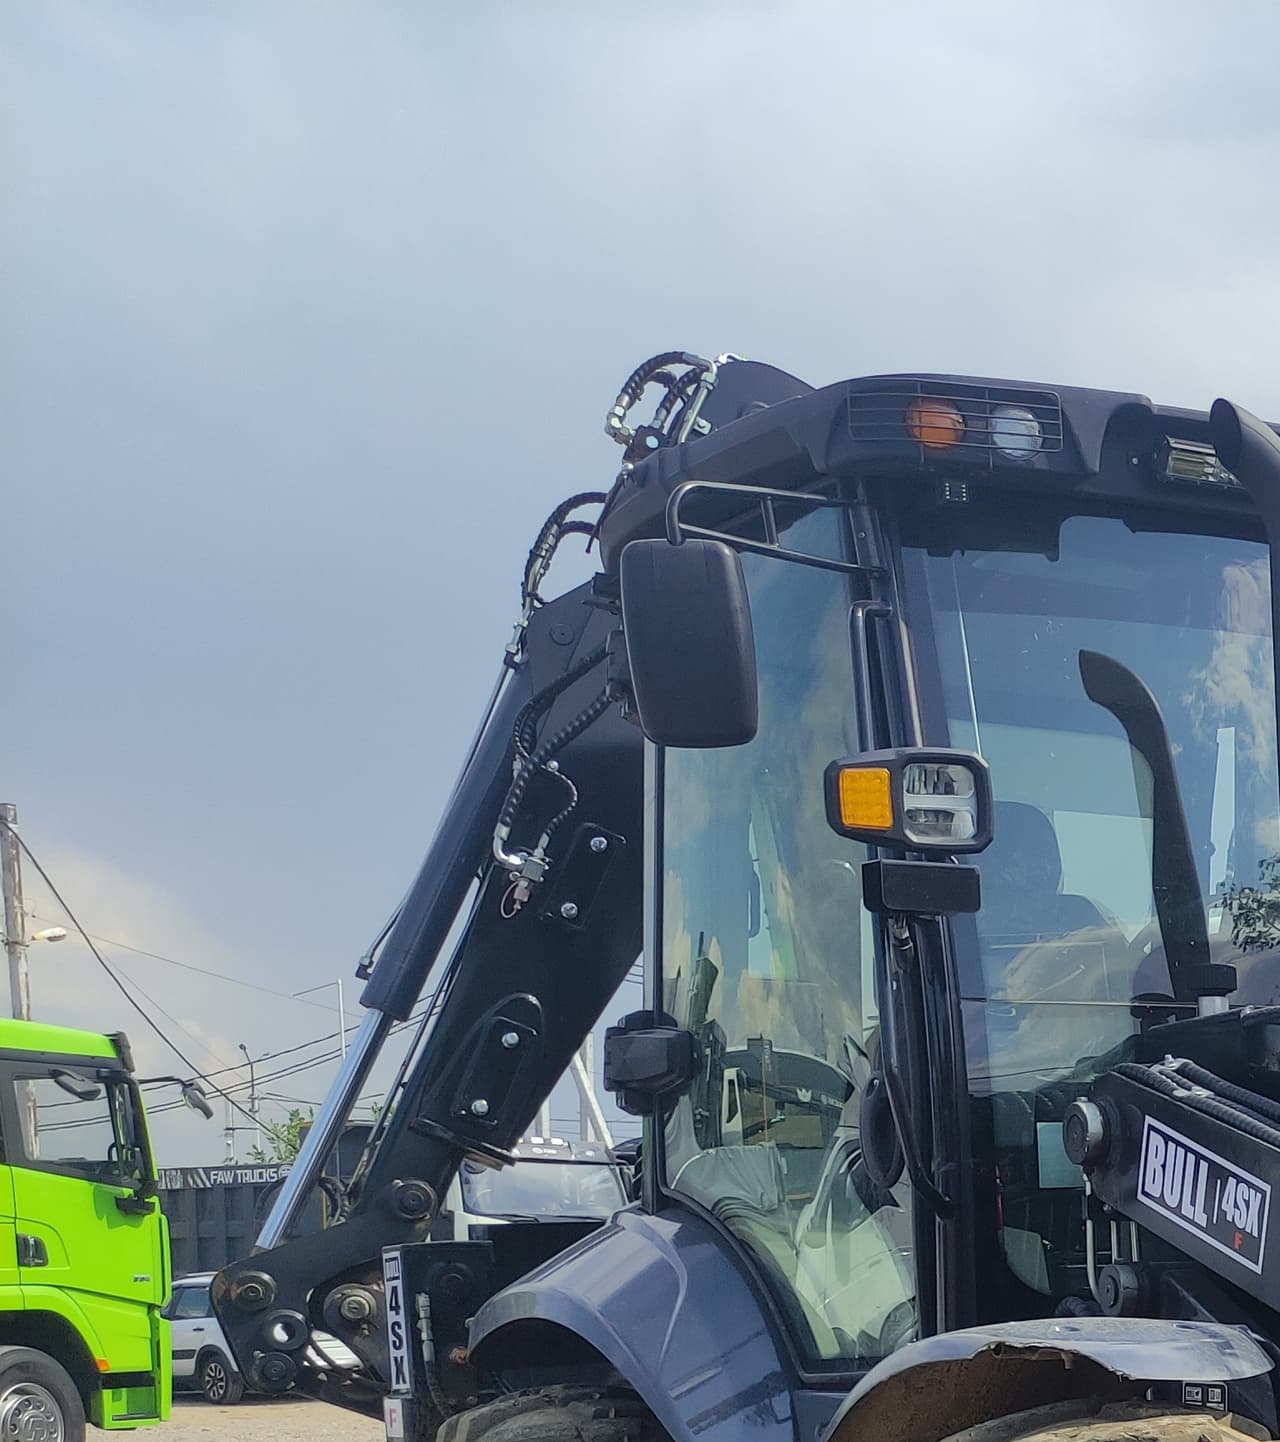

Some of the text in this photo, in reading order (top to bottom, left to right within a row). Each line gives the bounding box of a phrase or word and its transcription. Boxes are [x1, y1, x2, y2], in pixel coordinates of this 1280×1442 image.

[210, 1168, 278, 1185] FAW TRUCKS
[1142, 1127, 1264, 1239] BULL 4SX
[1232, 1231, 1243, 1250] F
[389, 1408, 397, 1429] F
